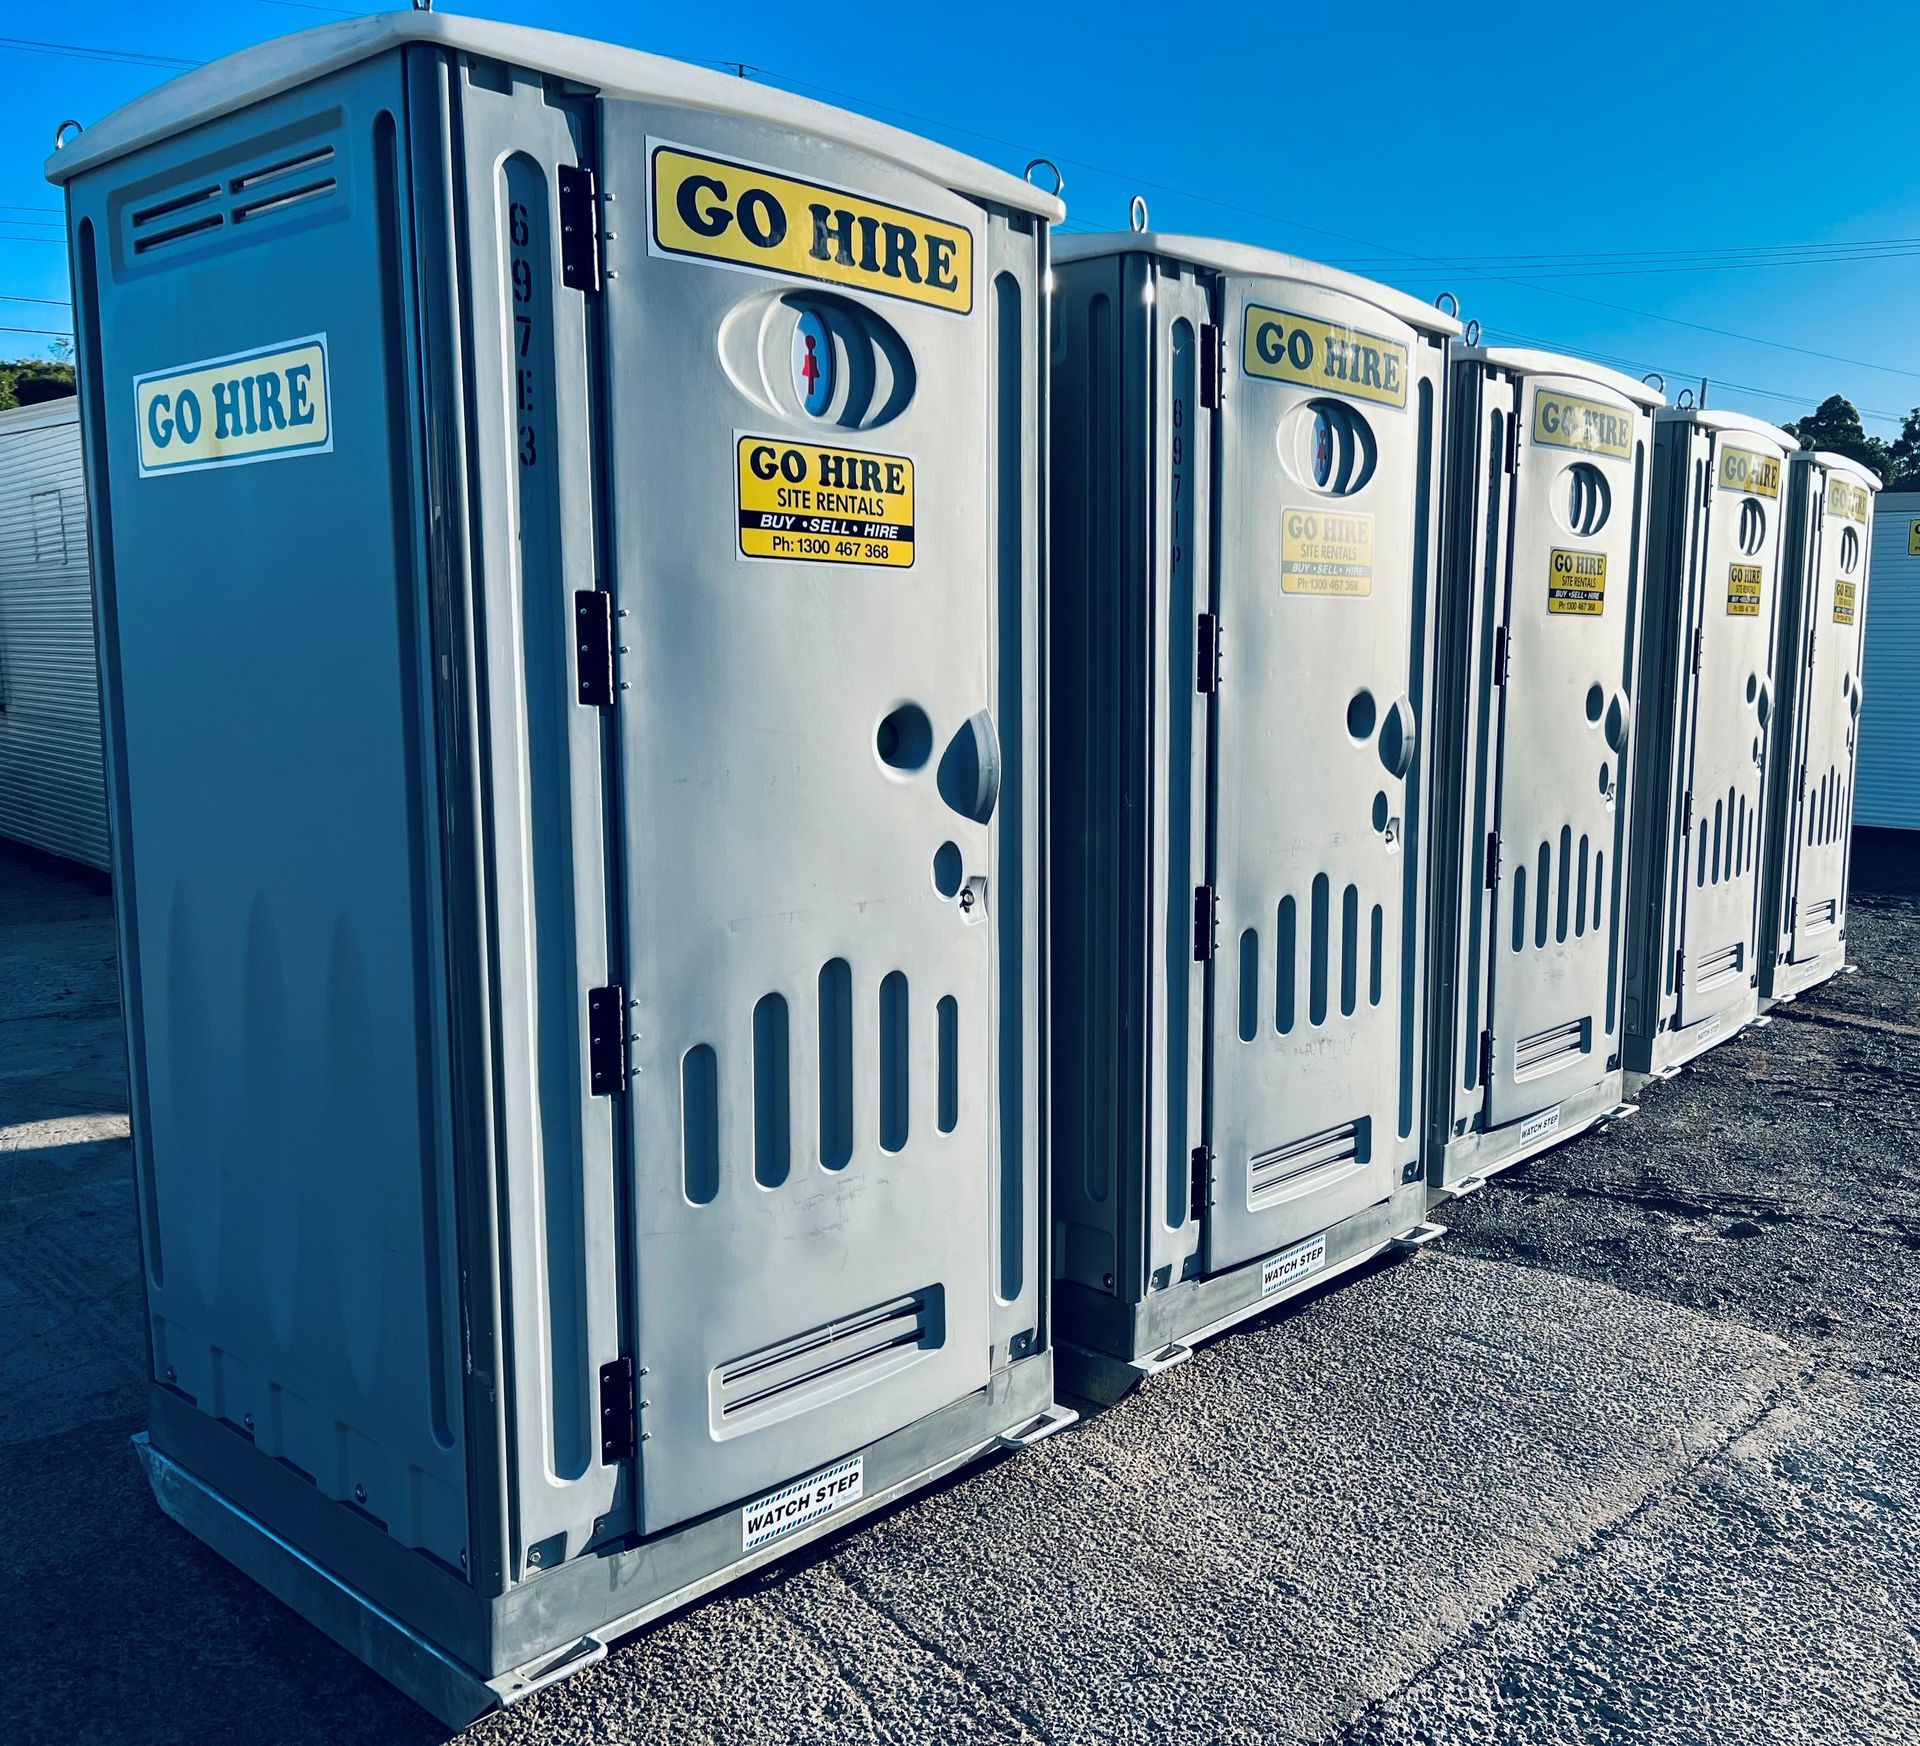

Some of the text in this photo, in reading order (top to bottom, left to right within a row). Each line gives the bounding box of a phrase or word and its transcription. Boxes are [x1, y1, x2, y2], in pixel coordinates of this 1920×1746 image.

[676, 175, 958, 292] GO HIRE
[1256, 322, 1399, 393] GO HIRE
[148, 364, 315, 448] GO HIRE
[1542, 402, 1579, 437] GO
[750, 446, 905, 495] GO HIRE
[1725, 455, 1747, 482] GO
[777, 488, 884, 516] SITE RENTALS
[1831, 488, 1847, 509] GO
[760, 514, 796, 529] BUY
[864, 524, 899, 539] HIRE
[1288, 514, 1368, 544] GO HIRE
[773, 536, 888, 559] Ph: 1300 467 368
[1301, 544, 1357, 560] SITE RENTALS
[1292, 563, 1311, 573] BUY
[1345, 566, 1364, 576] HIRE
[1555, 554, 1603, 576] GO HIRE
[1732, 568, 1743, 582] GO
[1311, 579, 1327, 590] 1300
[1329, 579, 1344, 591] 467
[1345, 580, 1358, 592] 368
[1264, 1247, 1323, 1284] WATCH STEP
[747, 1493, 811, 1534] WATCH
[816, 1472, 859, 1502] STEP
